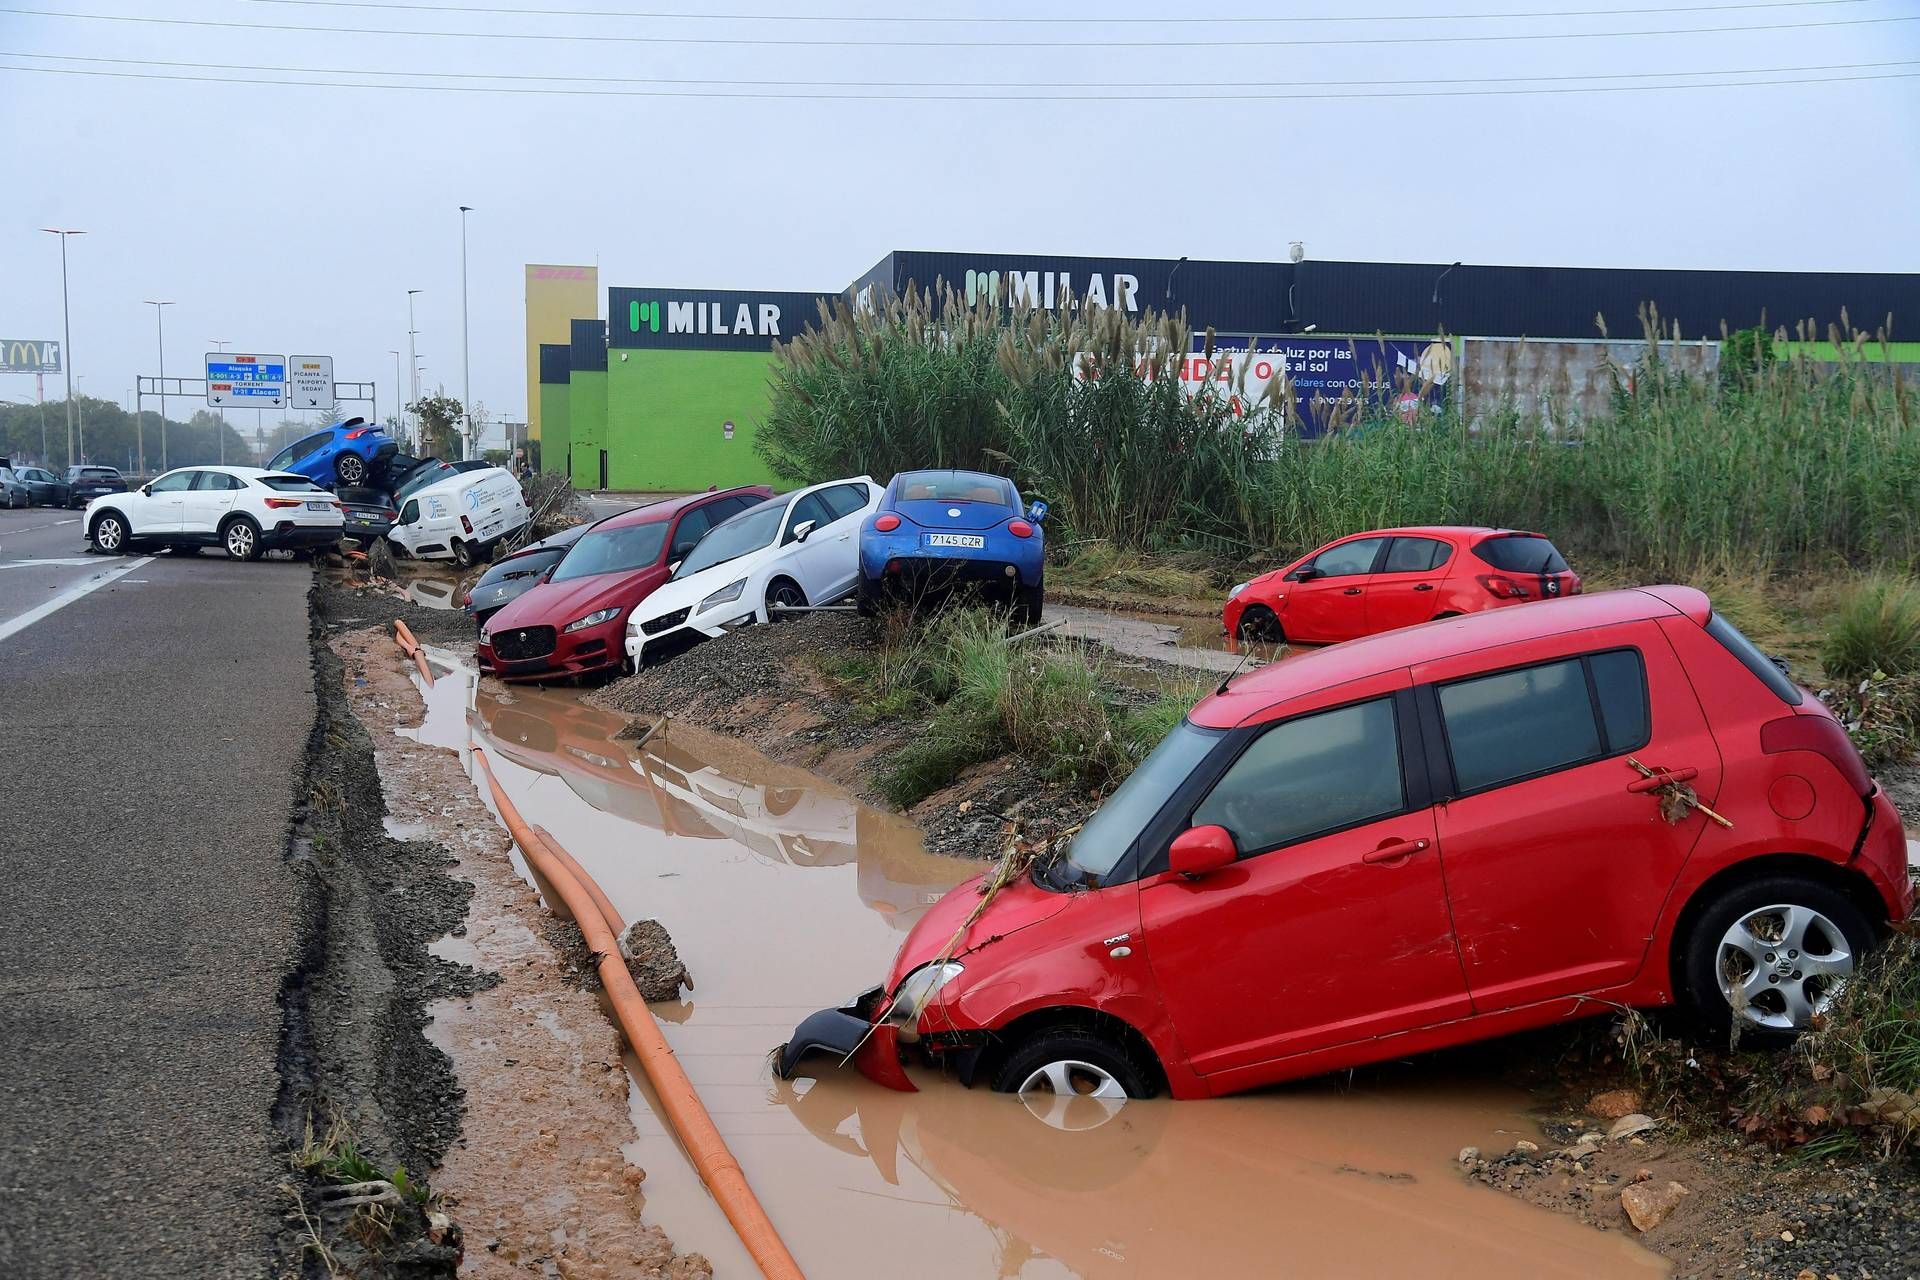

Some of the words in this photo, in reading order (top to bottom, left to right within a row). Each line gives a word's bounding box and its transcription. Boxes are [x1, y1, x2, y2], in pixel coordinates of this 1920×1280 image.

[1008, 270, 1139, 312] MILAR
[667, 301, 781, 336] MILAR
[1286, 347, 1305, 358] luz
[1308, 349, 1331, 360] por
[1334, 348, 1352, 359] las
[1294, 360, 1306, 371] al
[1309, 361, 1328, 372] sol
[1294, 378, 1324, 388] olares
[1326, 380, 1346, 388] con
[1348, 379, 1391, 390] Ocopus
[932, 535, 958, 545] 7145
[961, 537, 981, 547] CZR
